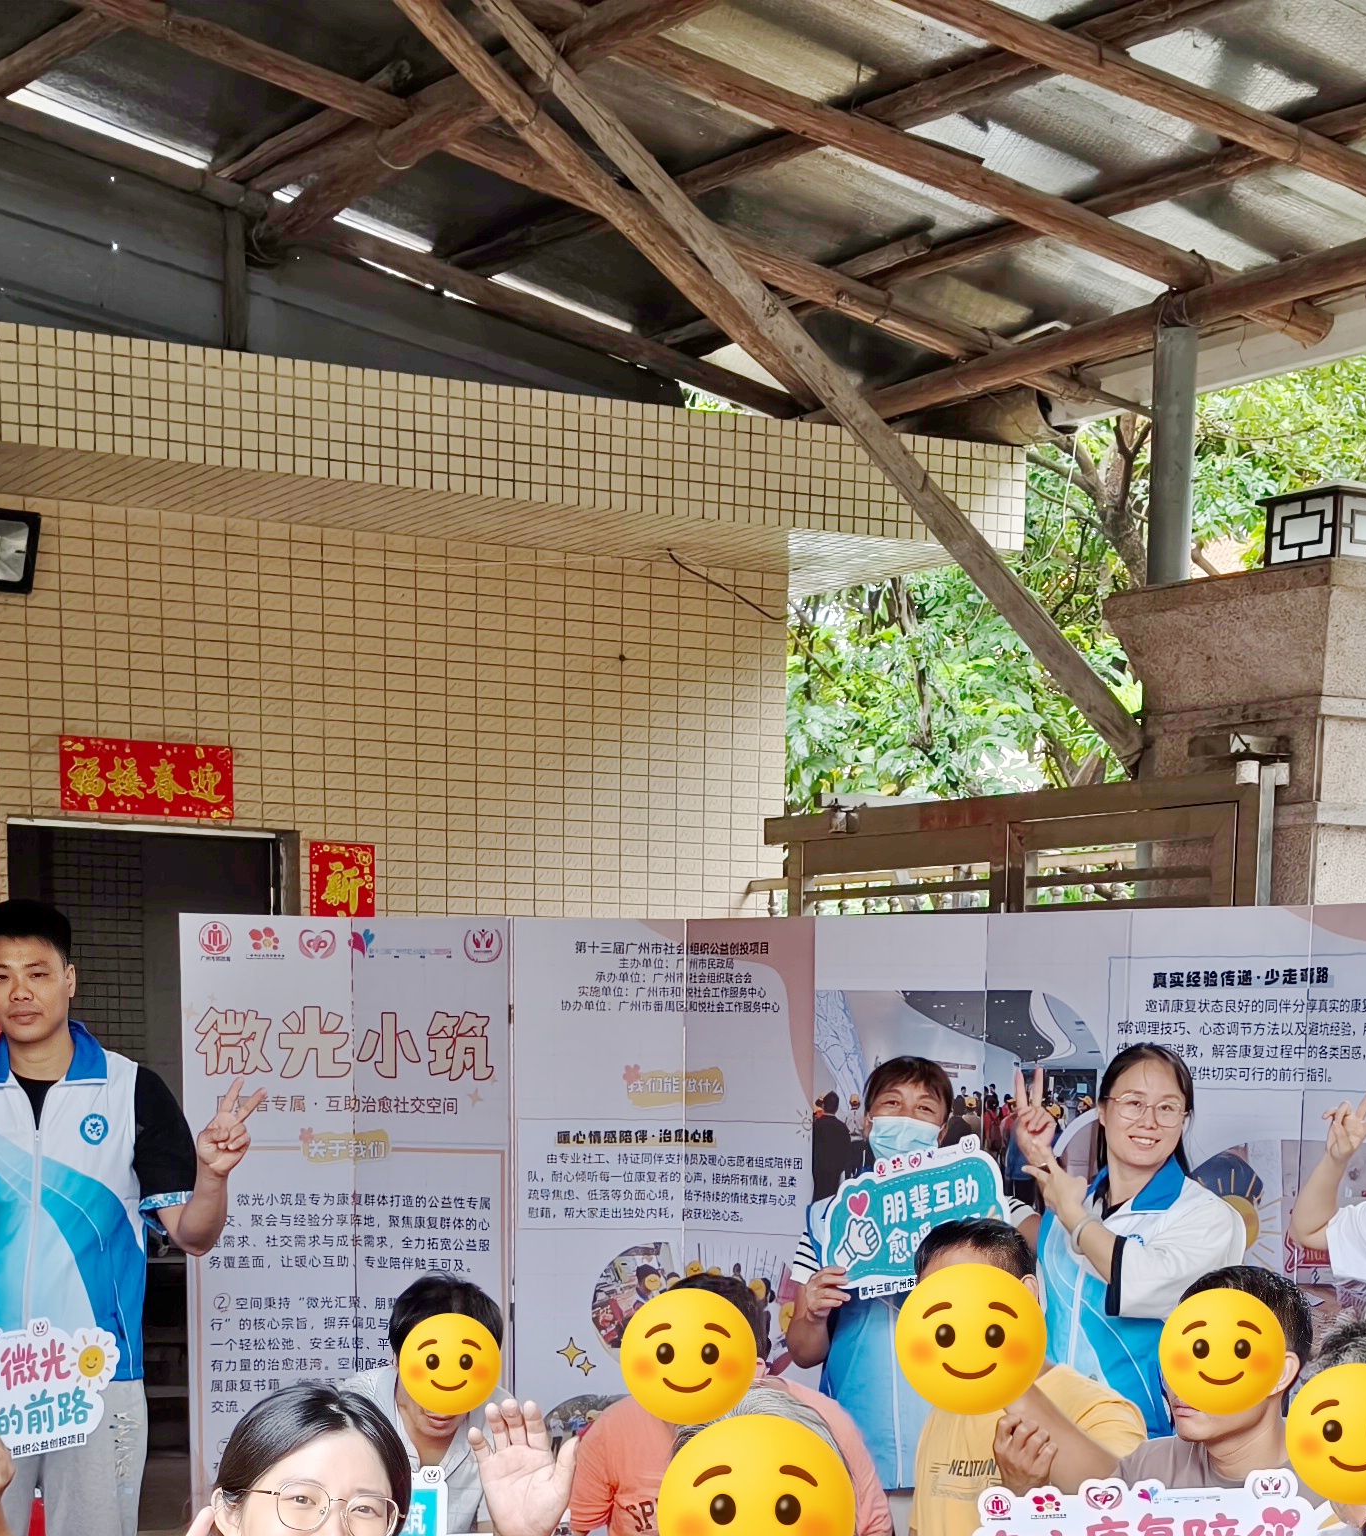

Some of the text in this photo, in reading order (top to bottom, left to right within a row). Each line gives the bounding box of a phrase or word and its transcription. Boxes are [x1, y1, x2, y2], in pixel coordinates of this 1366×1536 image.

[321, 861, 365, 917] 新
[575, 941, 769, 955] 第十三届广州市社会组织公益创投项目
[195, 1005, 494, 1081] 微光小筑
[628, 1077, 724, 1095] 我们能做什么
[217, 1095, 458, 1115] 者专属·互助治愈社交空间
[308, 1139, 386, 1158] 关于我们
[237, 1193, 491, 1211] 微光小筑是专为康复群体打造的公益性专属
[883, 1174, 979, 1226] 朋辈互助
[861, 1277, 917, 1297] 第十三届广州市
[626, 1498, 658, 1532] SP
